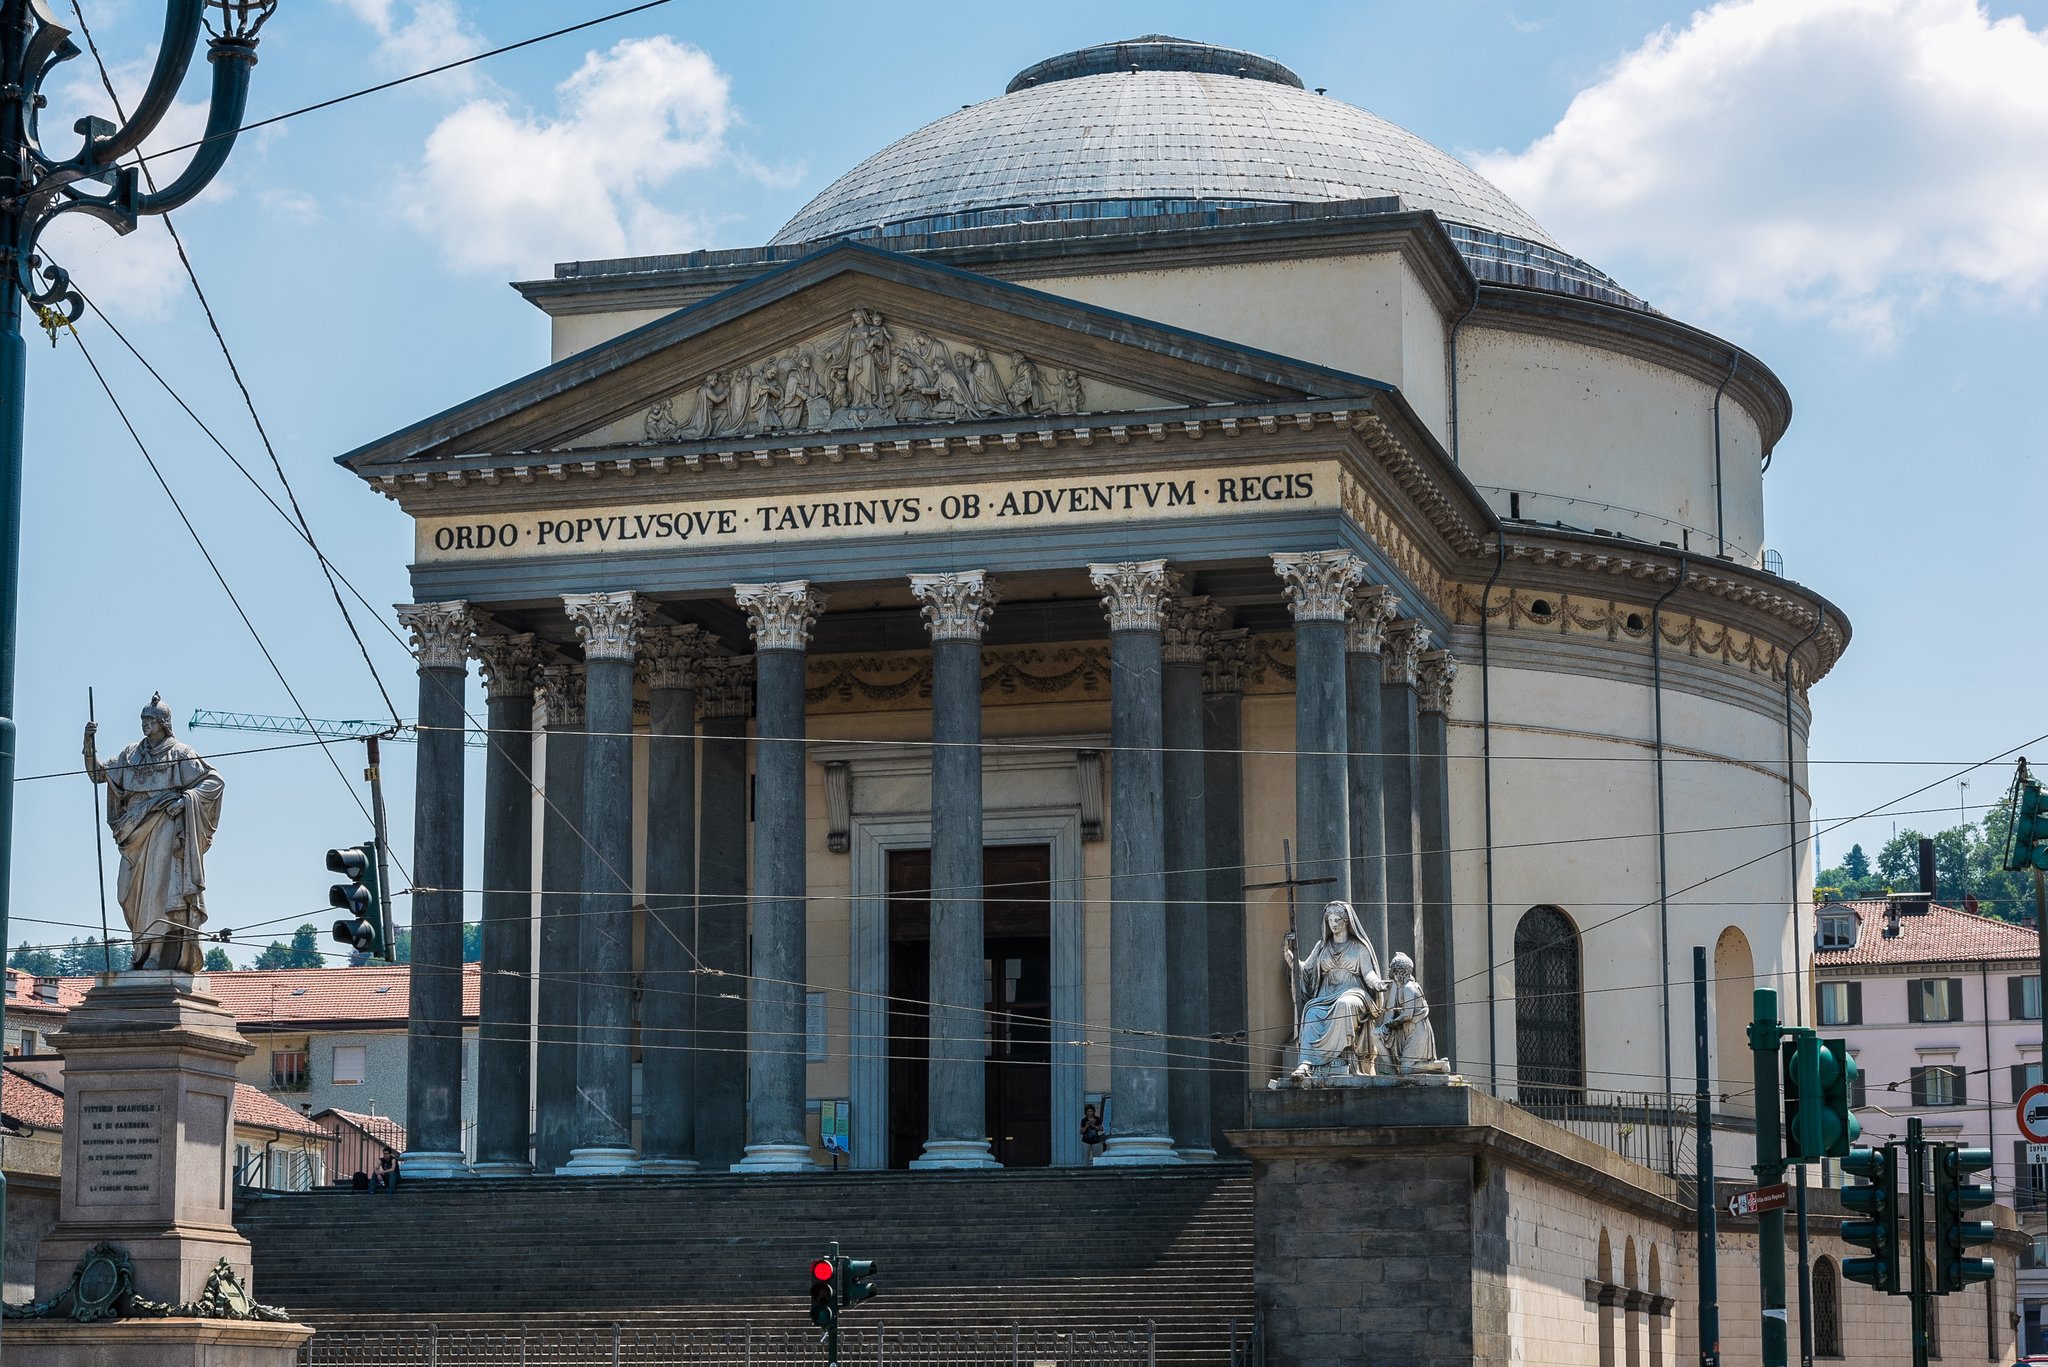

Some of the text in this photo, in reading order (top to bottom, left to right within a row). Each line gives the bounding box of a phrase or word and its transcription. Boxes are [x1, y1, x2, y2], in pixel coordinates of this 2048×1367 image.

[434, 472, 1314, 552] ORDO POPVLVSQVE TAVRINVS OB ADVENTVM REGIS
[83, 1105, 114, 1113] VITTORIO
[116, 1104, 155, 1113] EMANUELE
